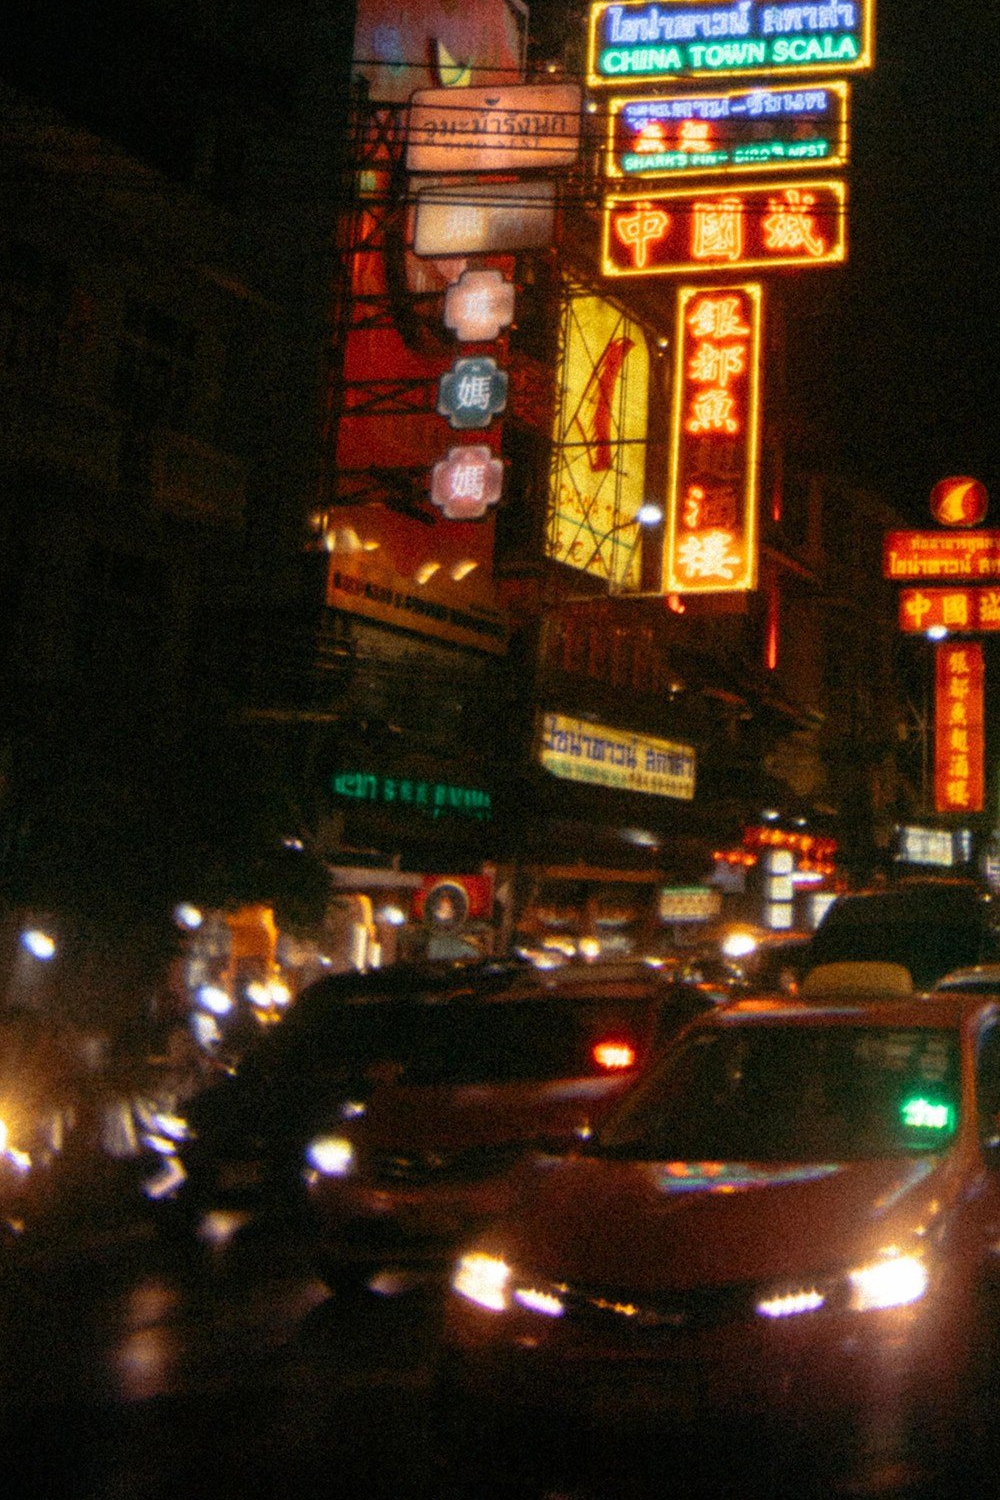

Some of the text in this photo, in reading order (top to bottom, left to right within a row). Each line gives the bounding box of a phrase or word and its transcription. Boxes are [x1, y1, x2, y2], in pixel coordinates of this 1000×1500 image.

[603, 35, 858, 74] CHINA TOWN SCALA
[677, 297, 751, 581] 銀都魚樓
